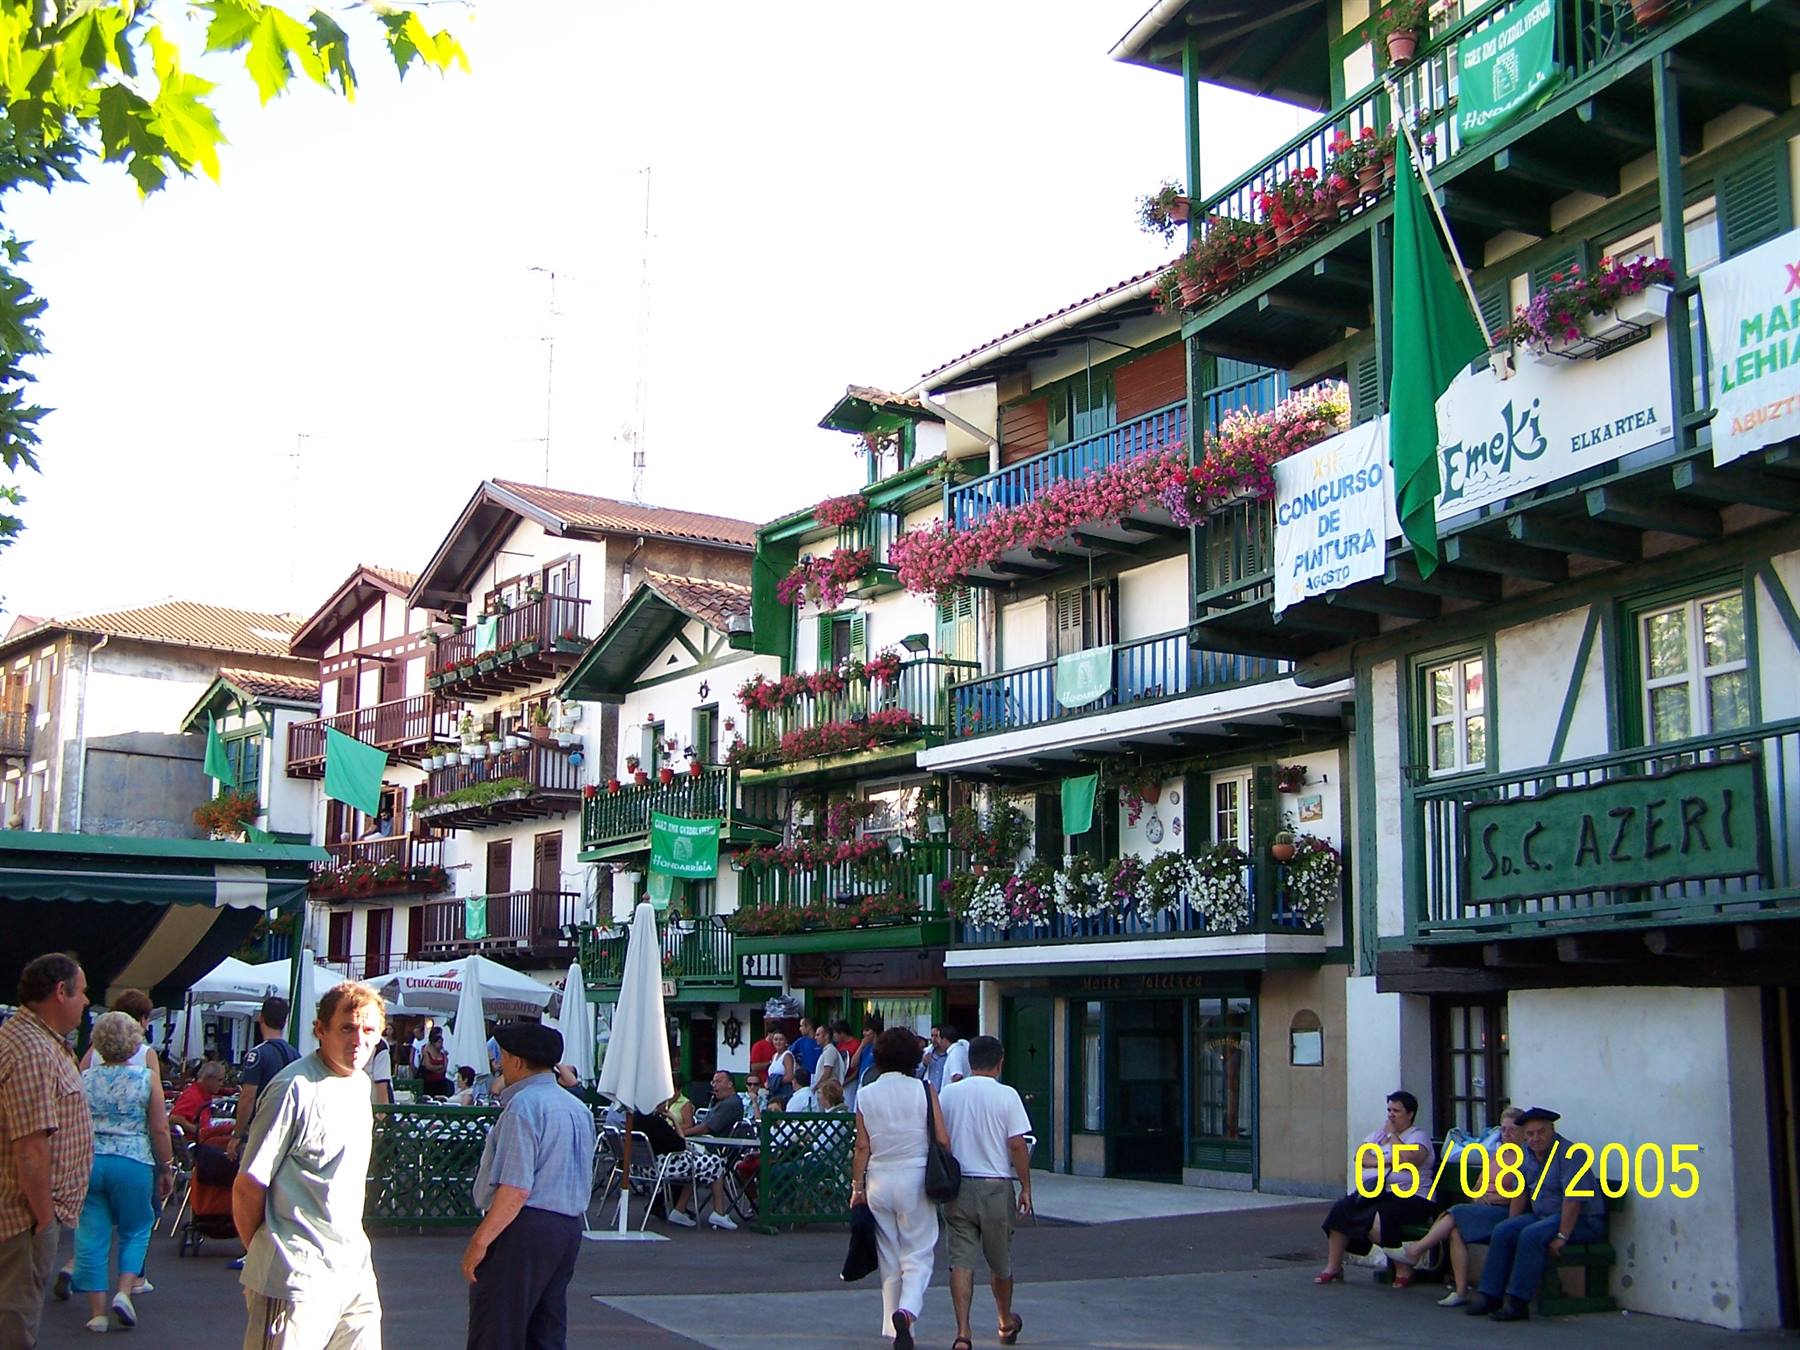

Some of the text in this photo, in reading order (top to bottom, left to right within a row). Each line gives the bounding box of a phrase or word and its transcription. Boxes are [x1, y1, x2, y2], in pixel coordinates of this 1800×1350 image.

[1570, 407, 1657, 453] ELKARTEA
[1278, 463, 1383, 526] CONCURSO
[1317, 508, 1340, 538] DE
[1293, 528, 1376, 577] PINTURA
[1305, 565, 1350, 590] AGOSTO
[1574, 788, 1734, 867] AZERI
[406, 976, 463, 992] Cruzcampo
